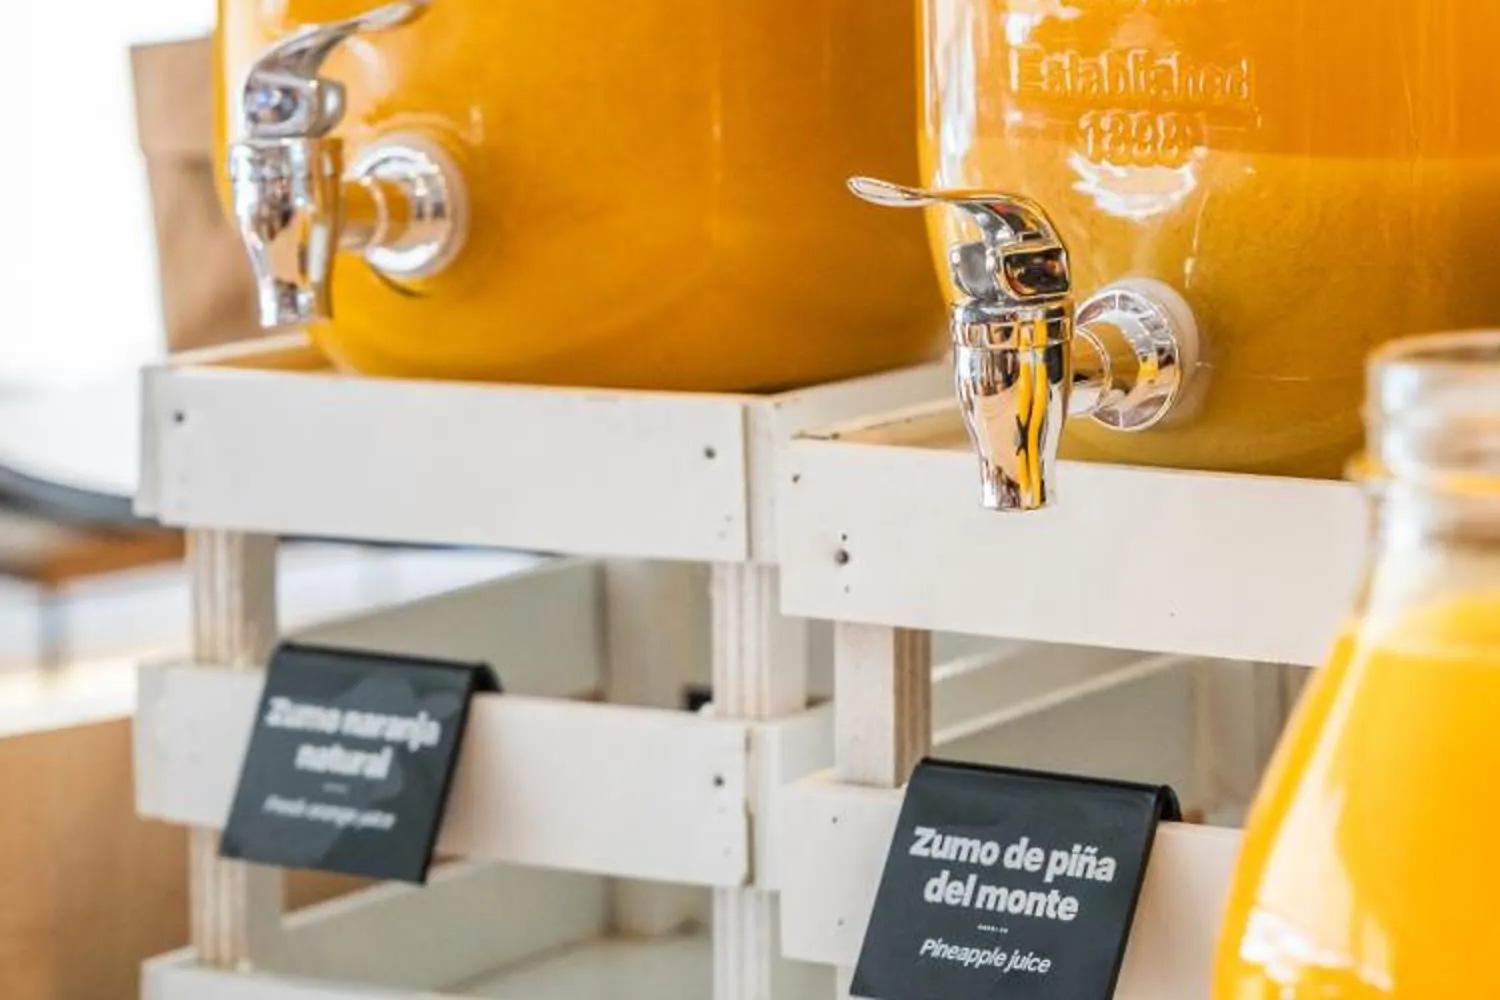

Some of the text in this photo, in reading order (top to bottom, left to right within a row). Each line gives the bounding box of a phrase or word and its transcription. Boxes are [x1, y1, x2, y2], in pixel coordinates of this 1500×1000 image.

[264, 695, 341, 733] Zumo
[909, 826, 1118, 883] Zumo de piña
[923, 869, 1079, 922] del monte
[919, 937, 1052, 975] Pineapple juice
